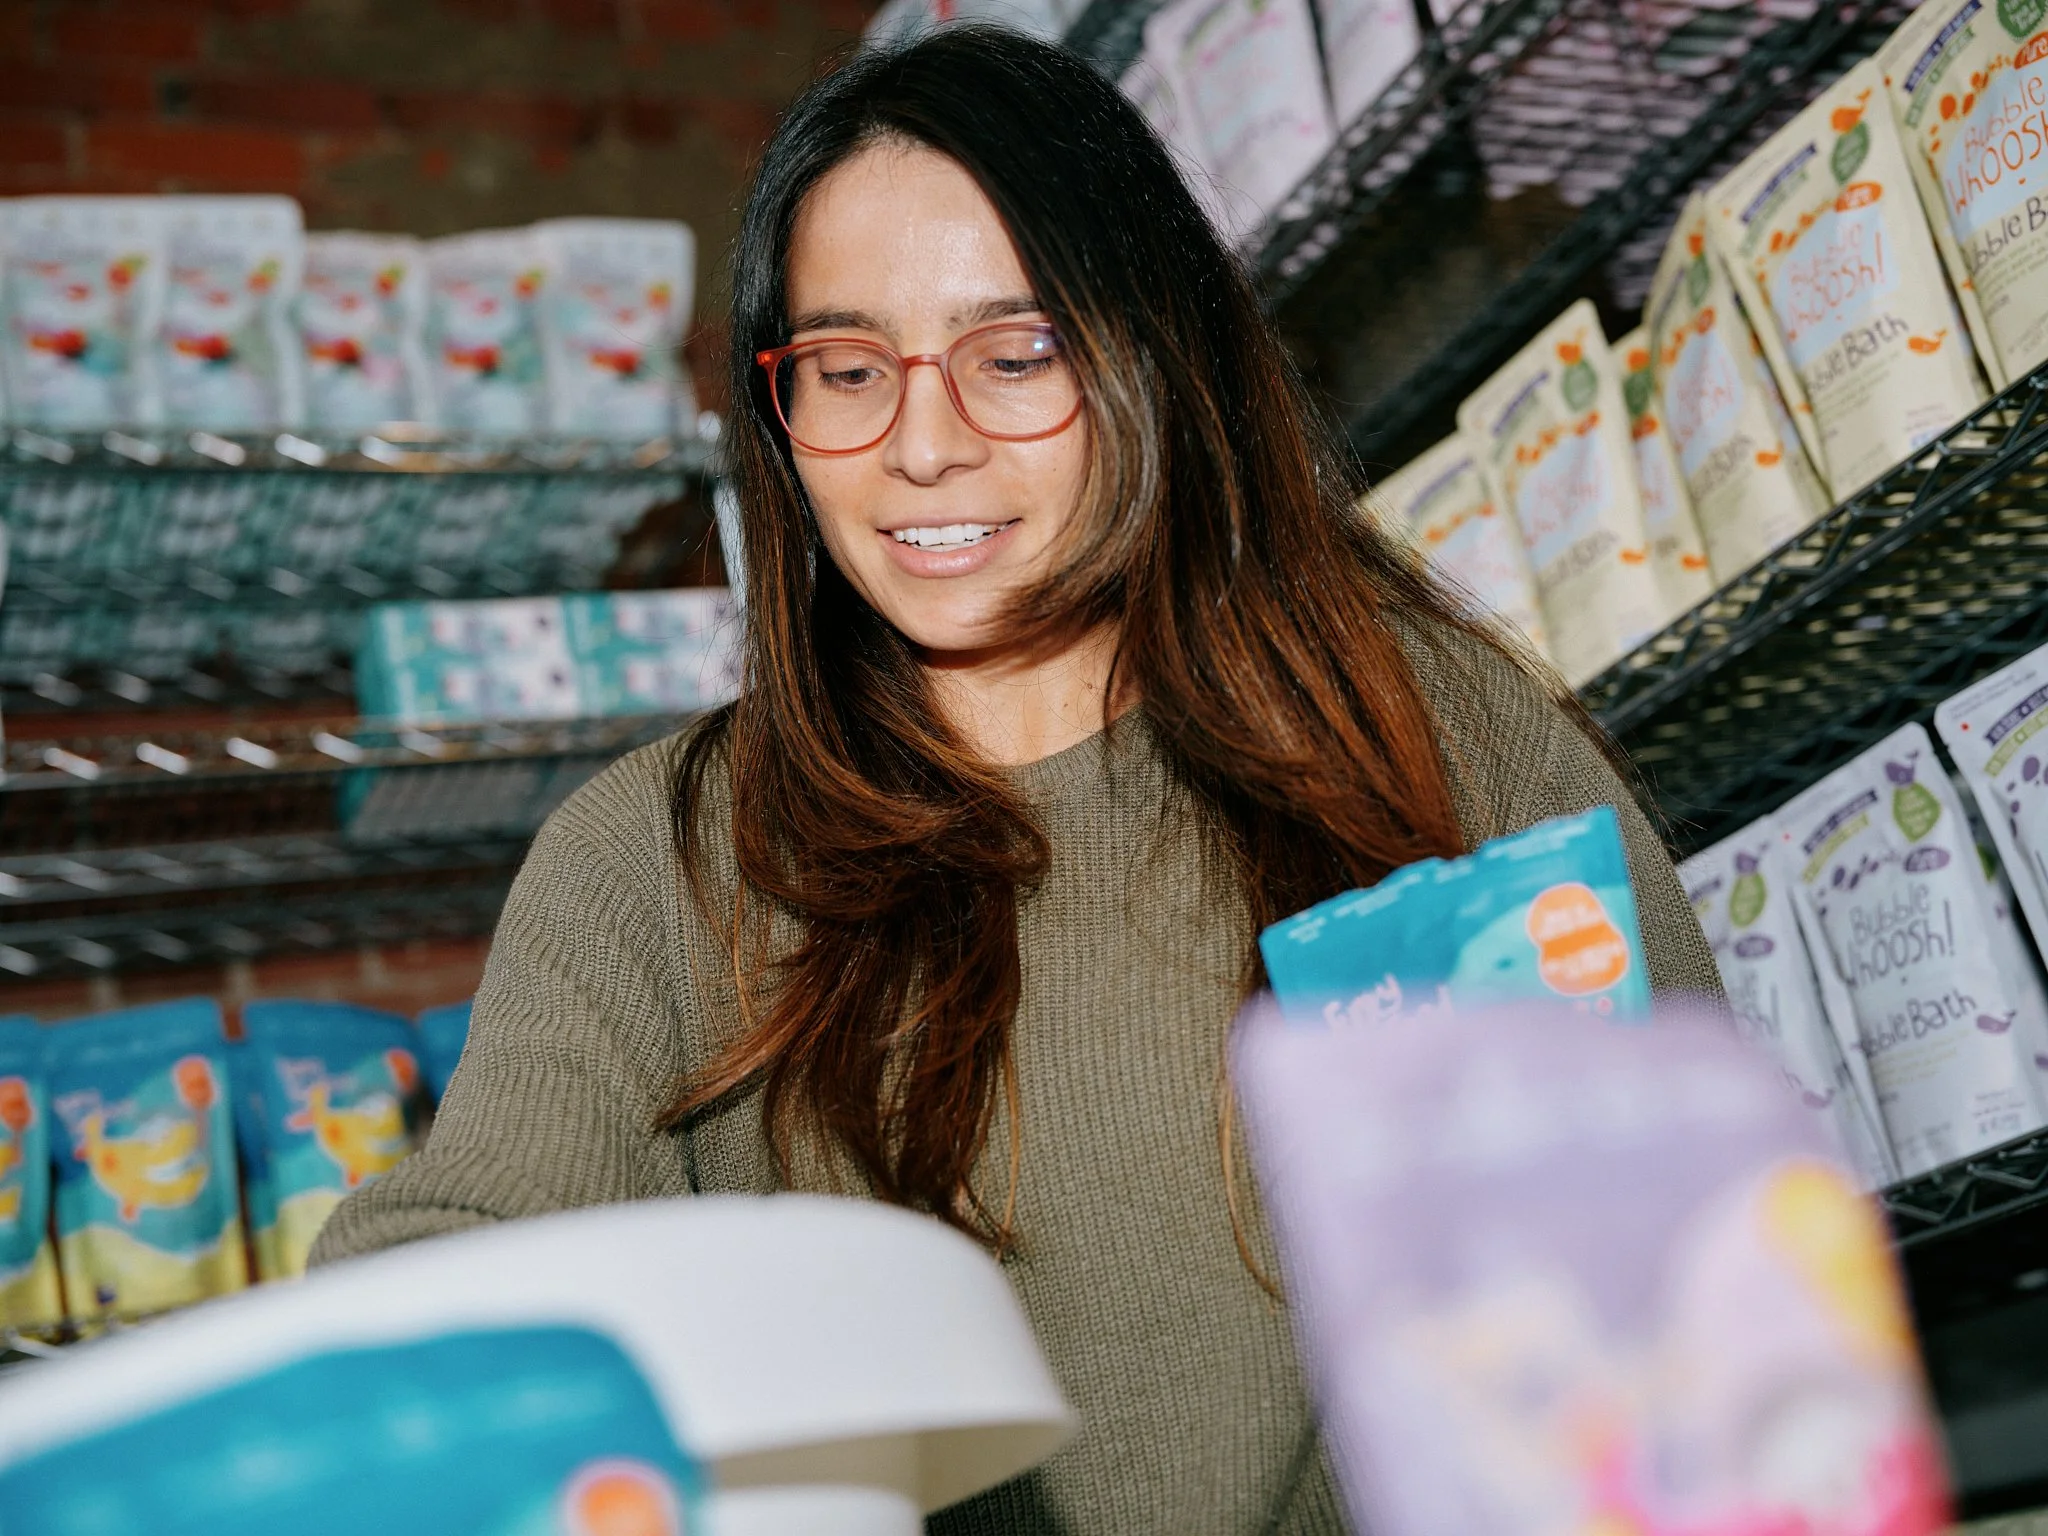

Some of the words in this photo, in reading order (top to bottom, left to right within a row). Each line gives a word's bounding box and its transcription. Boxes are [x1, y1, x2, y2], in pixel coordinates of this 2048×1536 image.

[1963, 75, 2046, 164] Bubble
[1972, 214, 2023, 277] bble
[1840, 311, 1910, 370] Bath
[1906, 986, 1977, 1040] Bath
